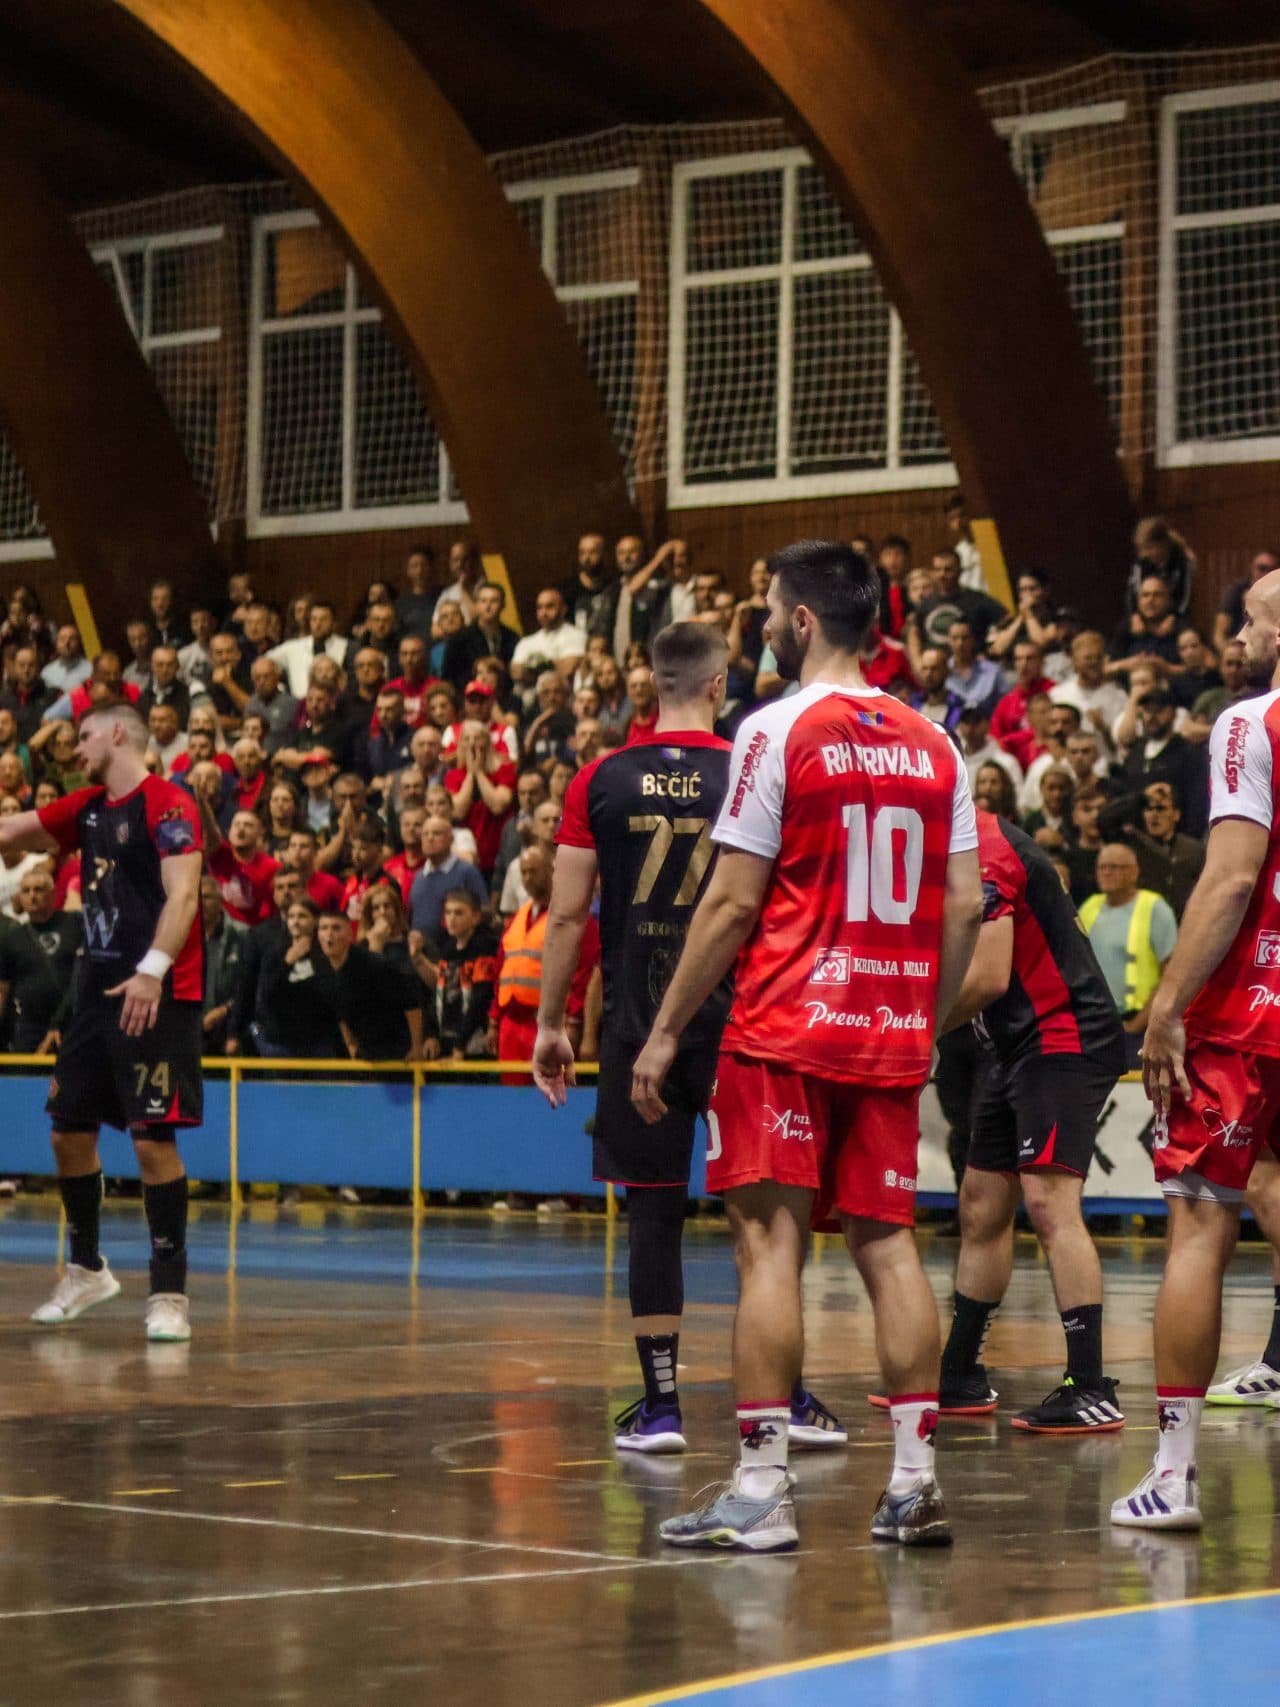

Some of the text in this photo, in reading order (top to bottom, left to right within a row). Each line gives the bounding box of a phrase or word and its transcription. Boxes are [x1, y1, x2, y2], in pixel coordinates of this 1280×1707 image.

[728, 731, 768, 818] RESTORAN
[1224, 717, 1246, 794] RESTORAN
[642, 771, 702, 798] BEČIĆ
[629, 815, 716, 906] 77
[842, 804, 925, 925] 10
[853, 957, 900, 976] KRIVAJA
[804, 1001, 872, 1029] Prevoz
[134, 1062, 169, 1097] 74
